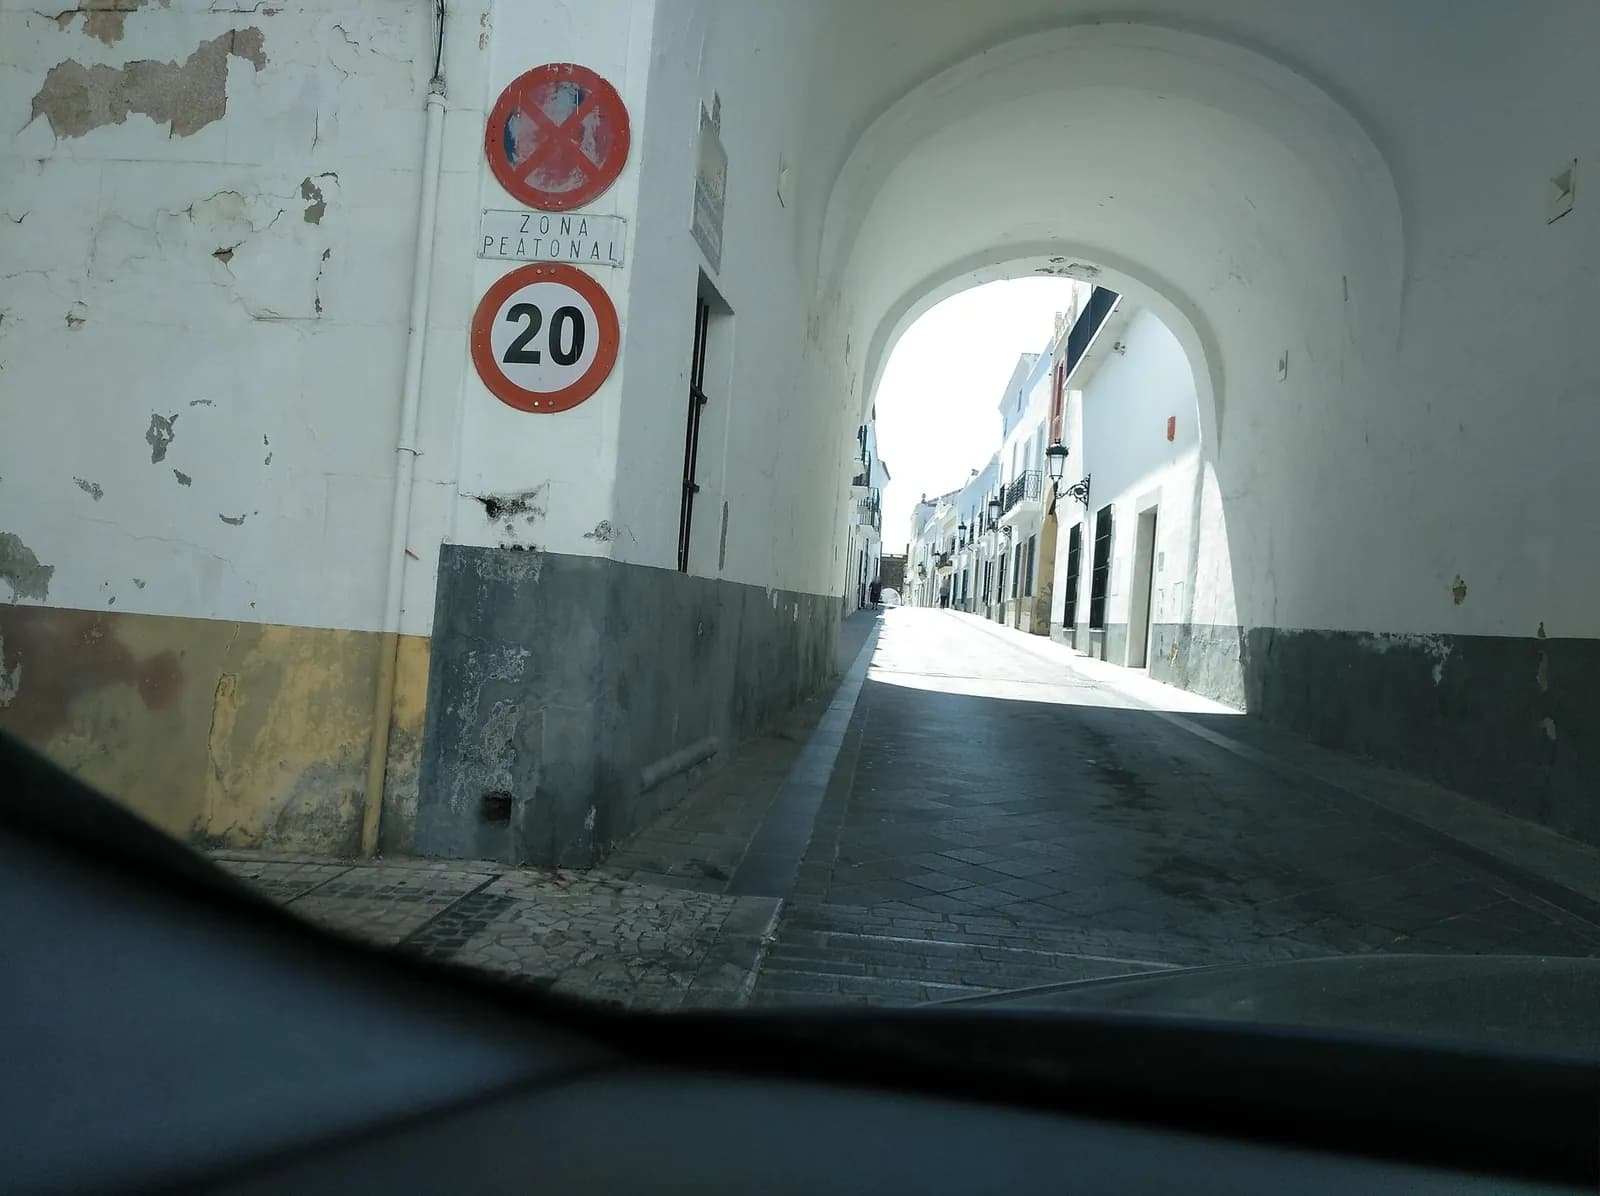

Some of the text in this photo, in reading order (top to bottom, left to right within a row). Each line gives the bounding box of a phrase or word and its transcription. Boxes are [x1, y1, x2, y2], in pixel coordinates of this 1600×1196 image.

[519, 215, 588, 236] ZONA
[483, 236, 618, 261] PEATONAL
[502, 302, 586, 366] 20
